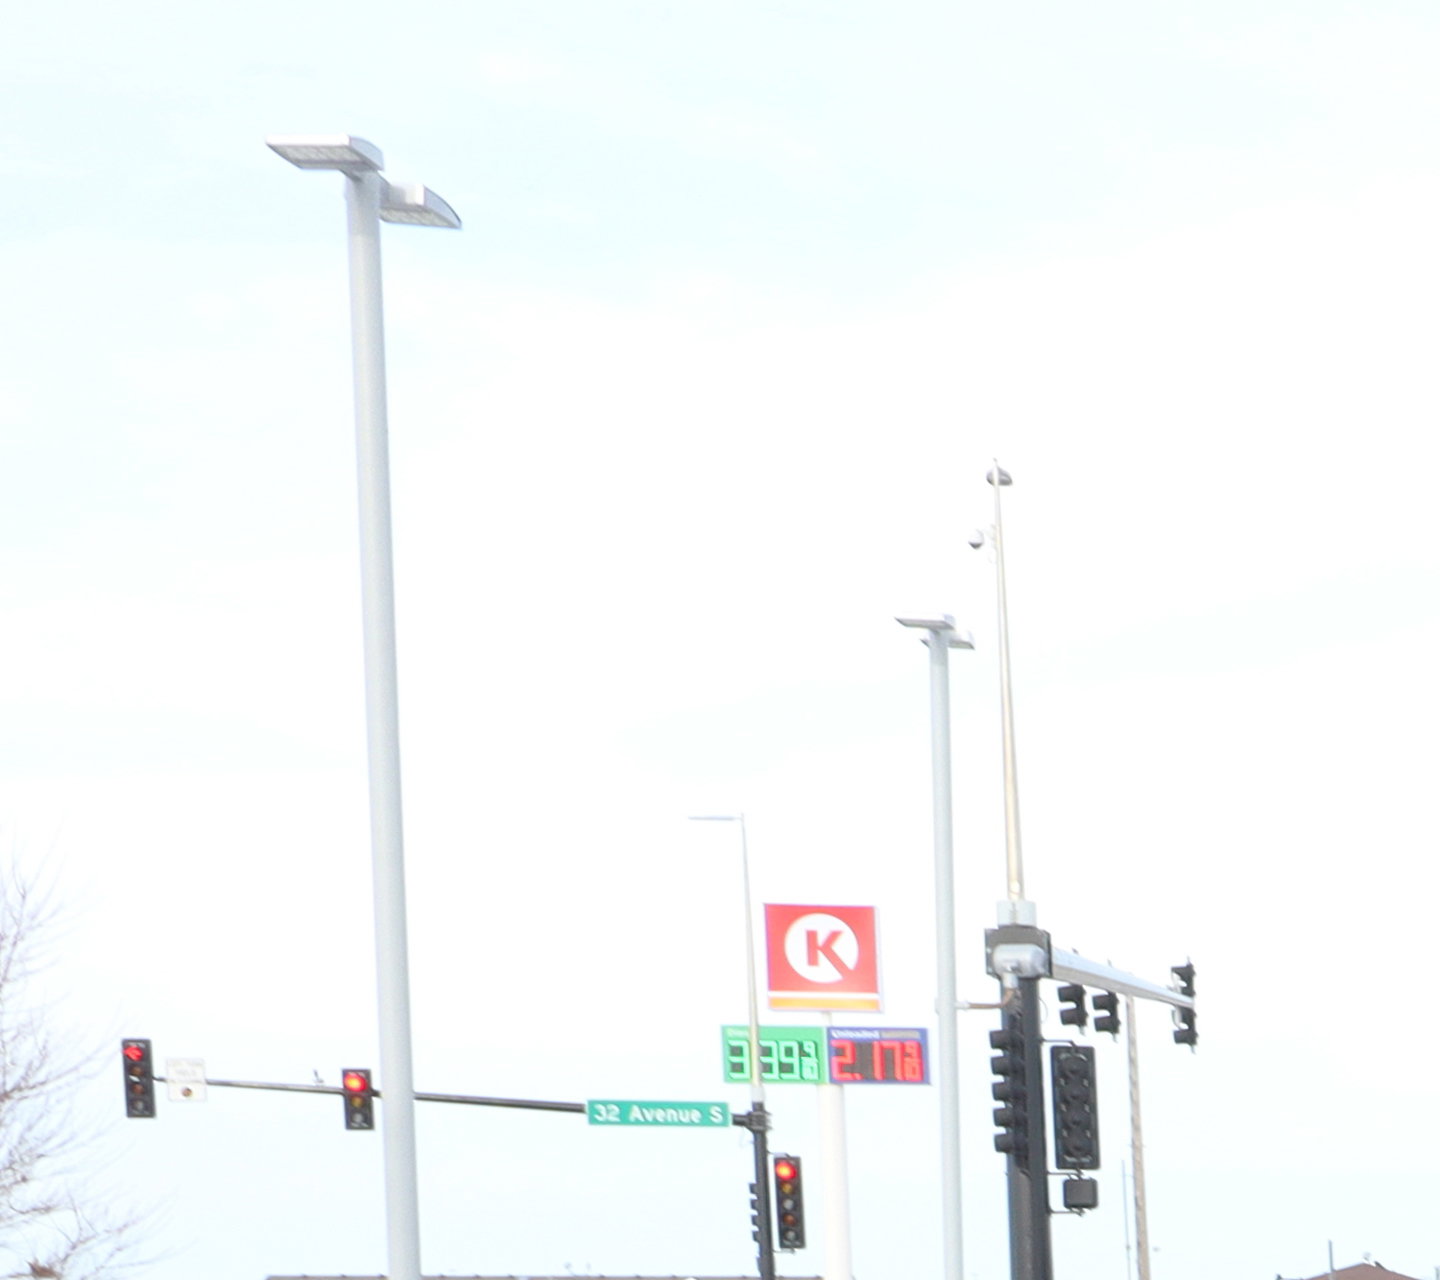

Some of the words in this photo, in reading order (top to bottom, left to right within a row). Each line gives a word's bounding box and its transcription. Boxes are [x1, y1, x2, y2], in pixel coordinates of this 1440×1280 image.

[594, 1103, 621, 1122] 32
[629, 1104, 702, 1123] Avenue
[709, 1105, 723, 1123] S
